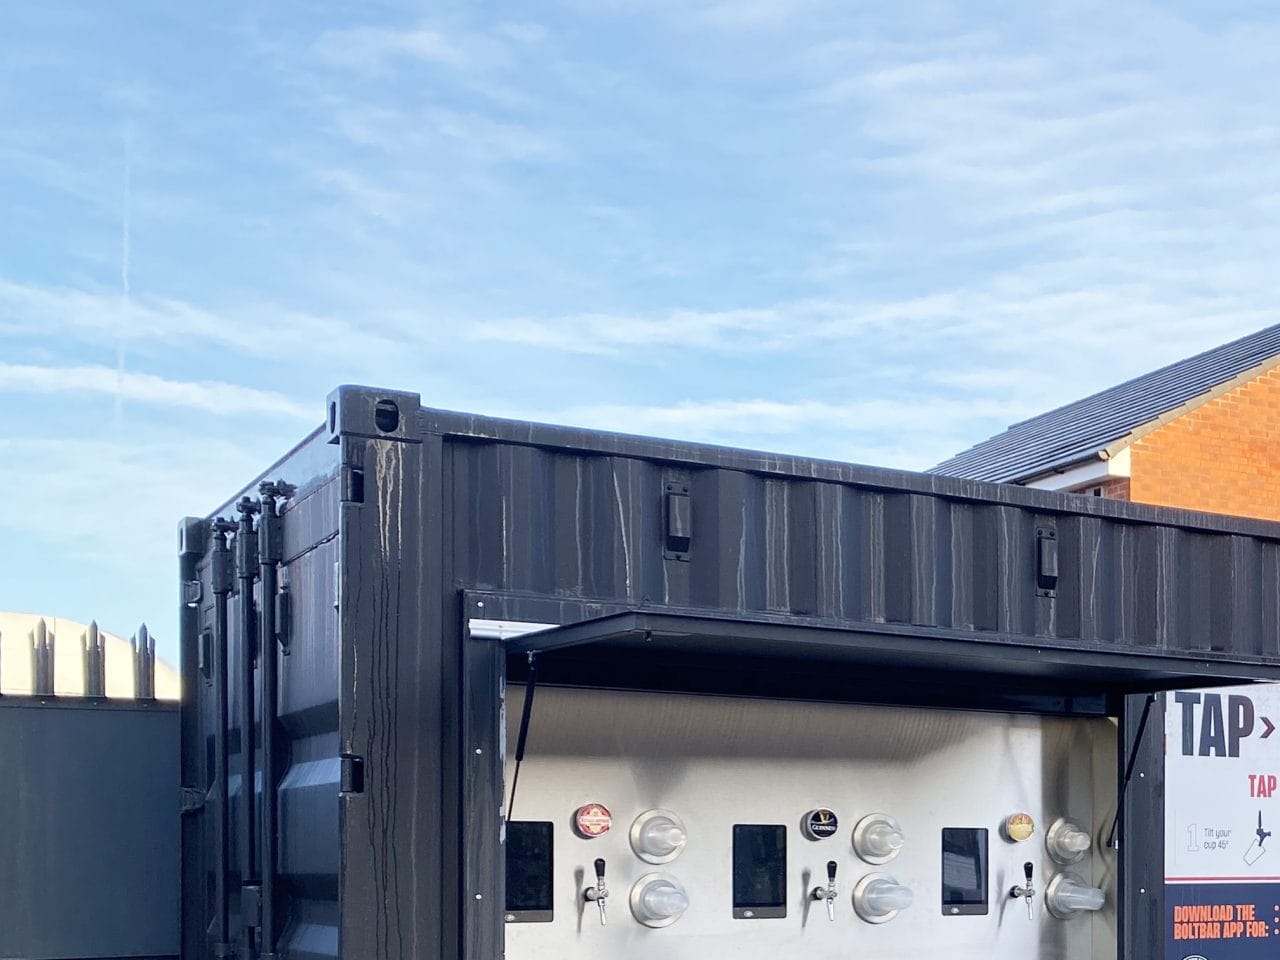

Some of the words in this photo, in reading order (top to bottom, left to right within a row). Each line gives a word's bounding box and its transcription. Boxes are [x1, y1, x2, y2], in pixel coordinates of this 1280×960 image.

[1175, 691, 1254, 758] TAP
[1248, 774, 1276, 797] TAP
[1204, 828, 1214, 838] Tilt
[1215, 829, 1231, 840] your
[1204, 842, 1215, 851] cup
[1174, 905, 1233, 922] DOWNLOAD
[1236, 904, 1255, 921] THE
[1174, 922, 1220, 939] BOLTBAR
[1223, 922, 1244, 938] APP
[1246, 921, 1269, 938] FOR:
